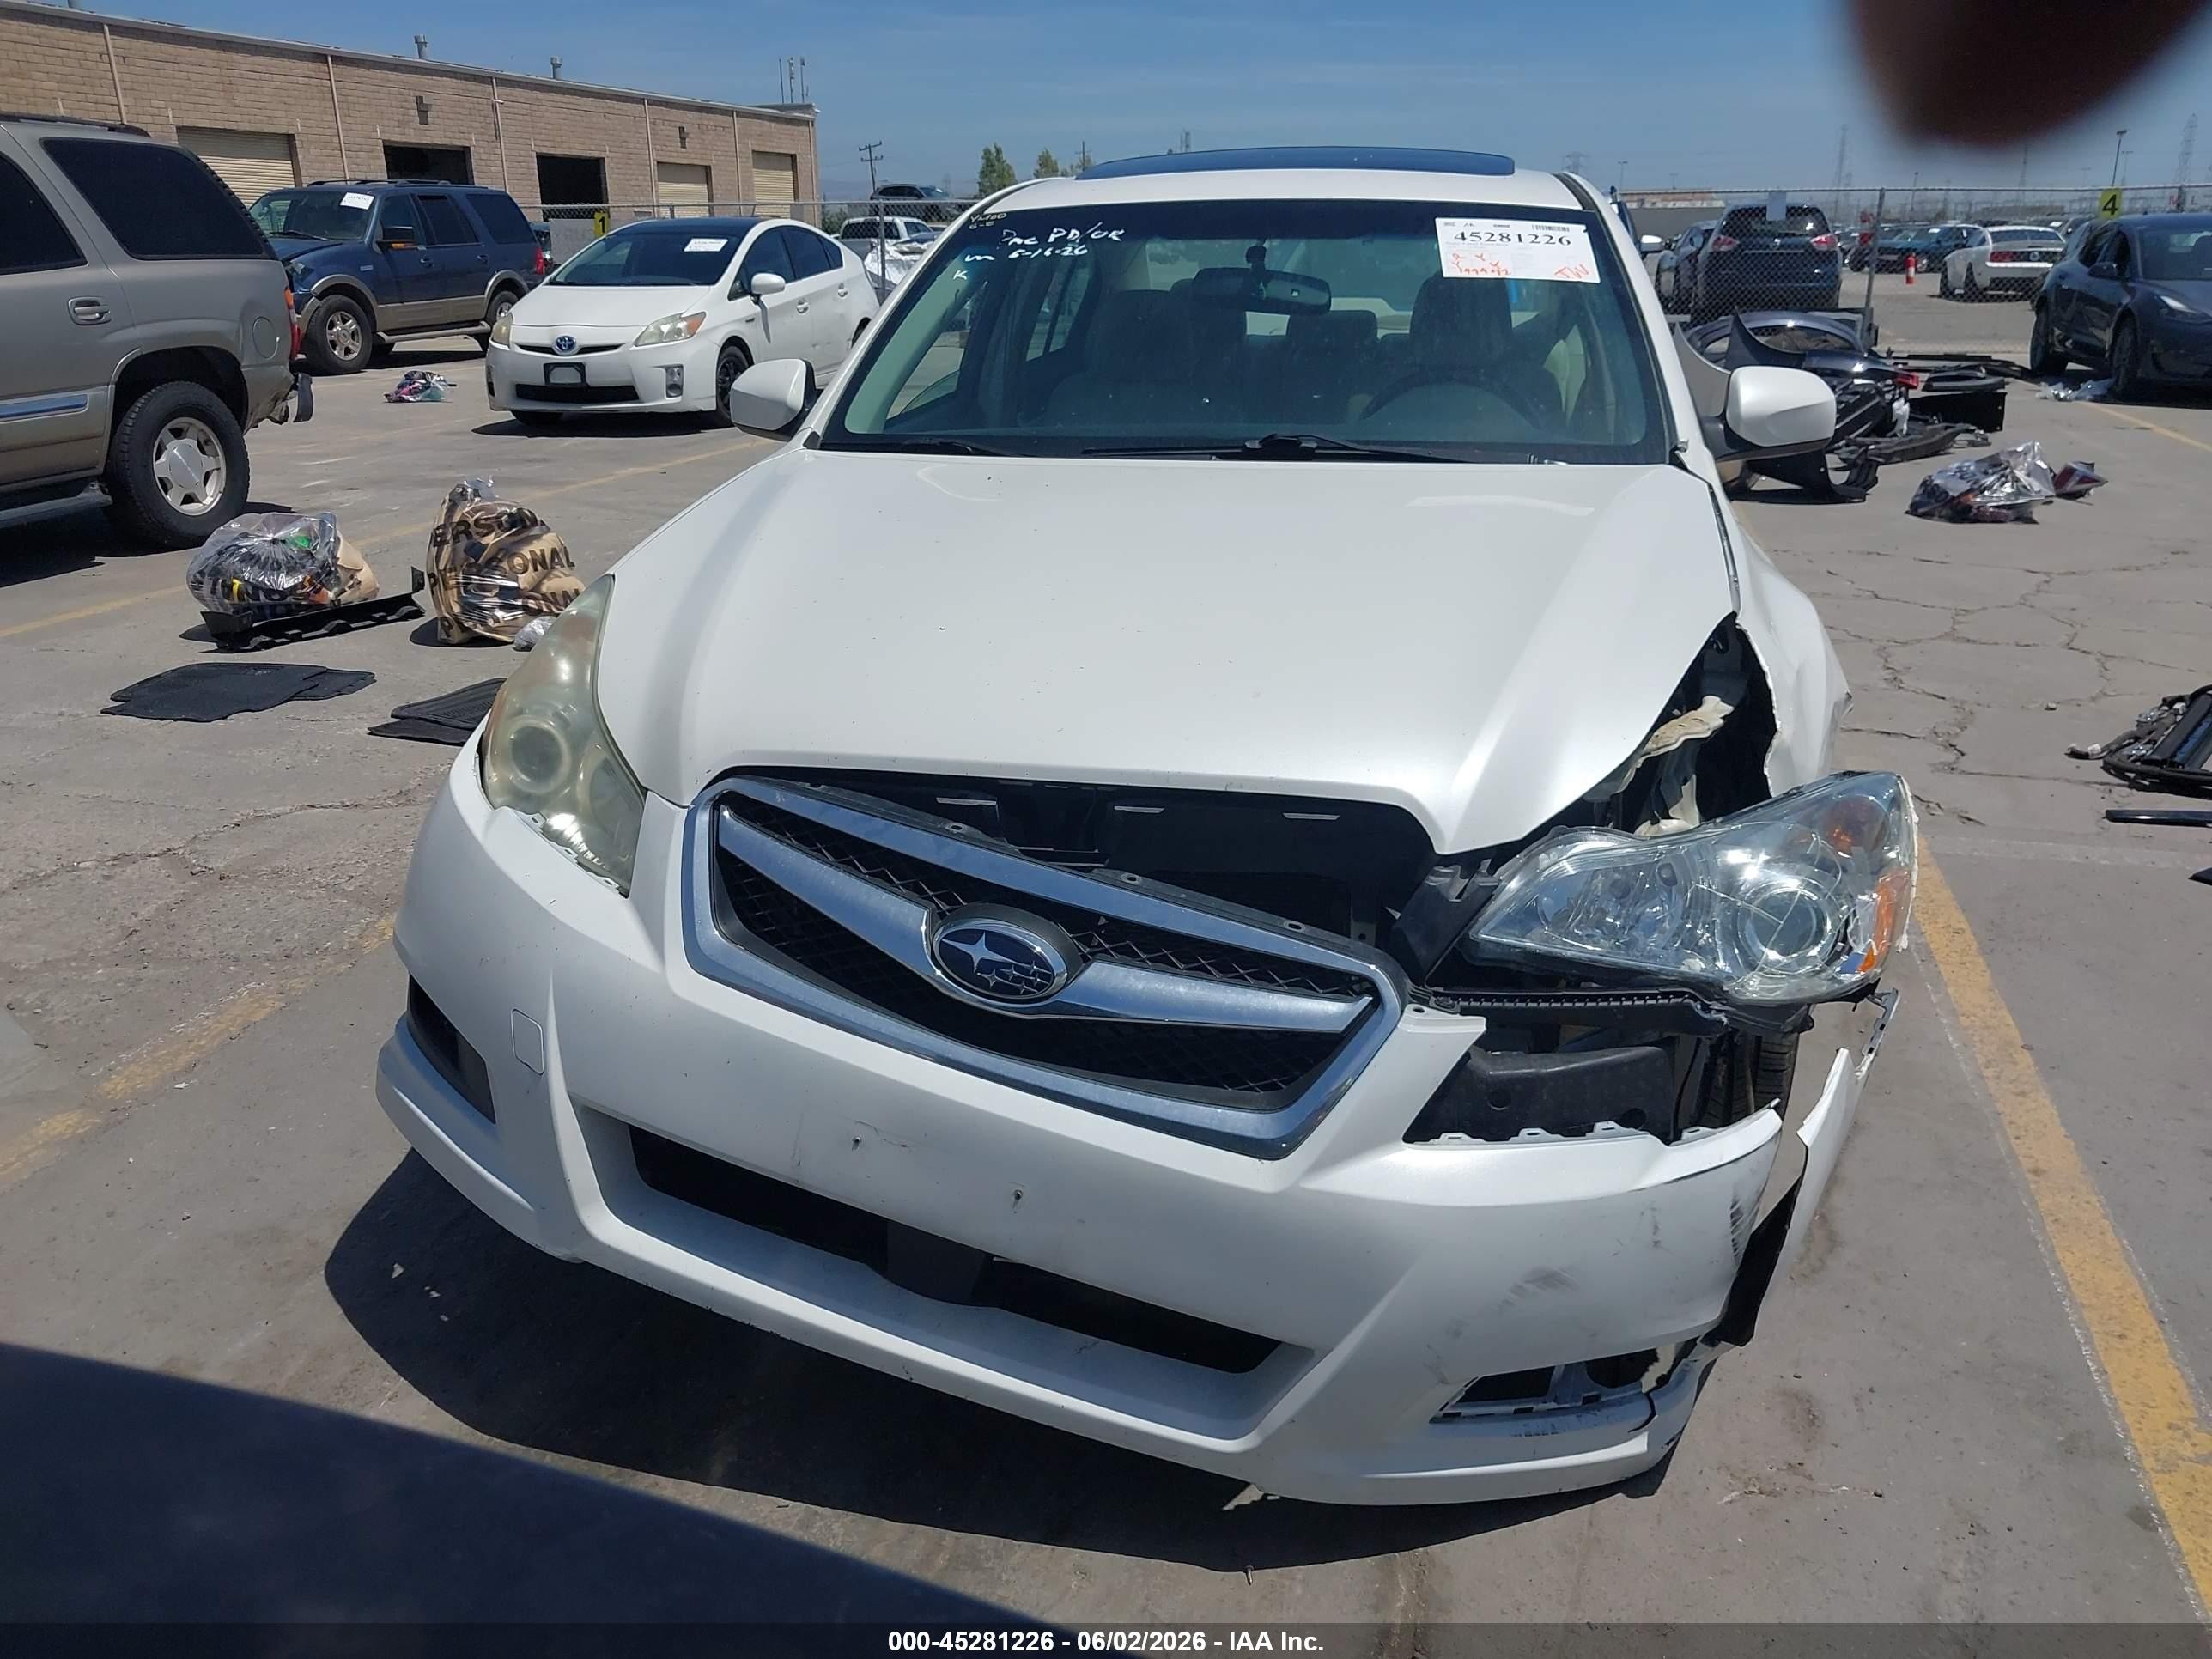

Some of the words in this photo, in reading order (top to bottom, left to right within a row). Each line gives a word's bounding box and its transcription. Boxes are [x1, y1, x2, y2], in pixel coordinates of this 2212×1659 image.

[2101, 193, 2118, 216] 4
[598, 216, 606, 234] 1
[1453, 231, 1571, 246] 45281226
